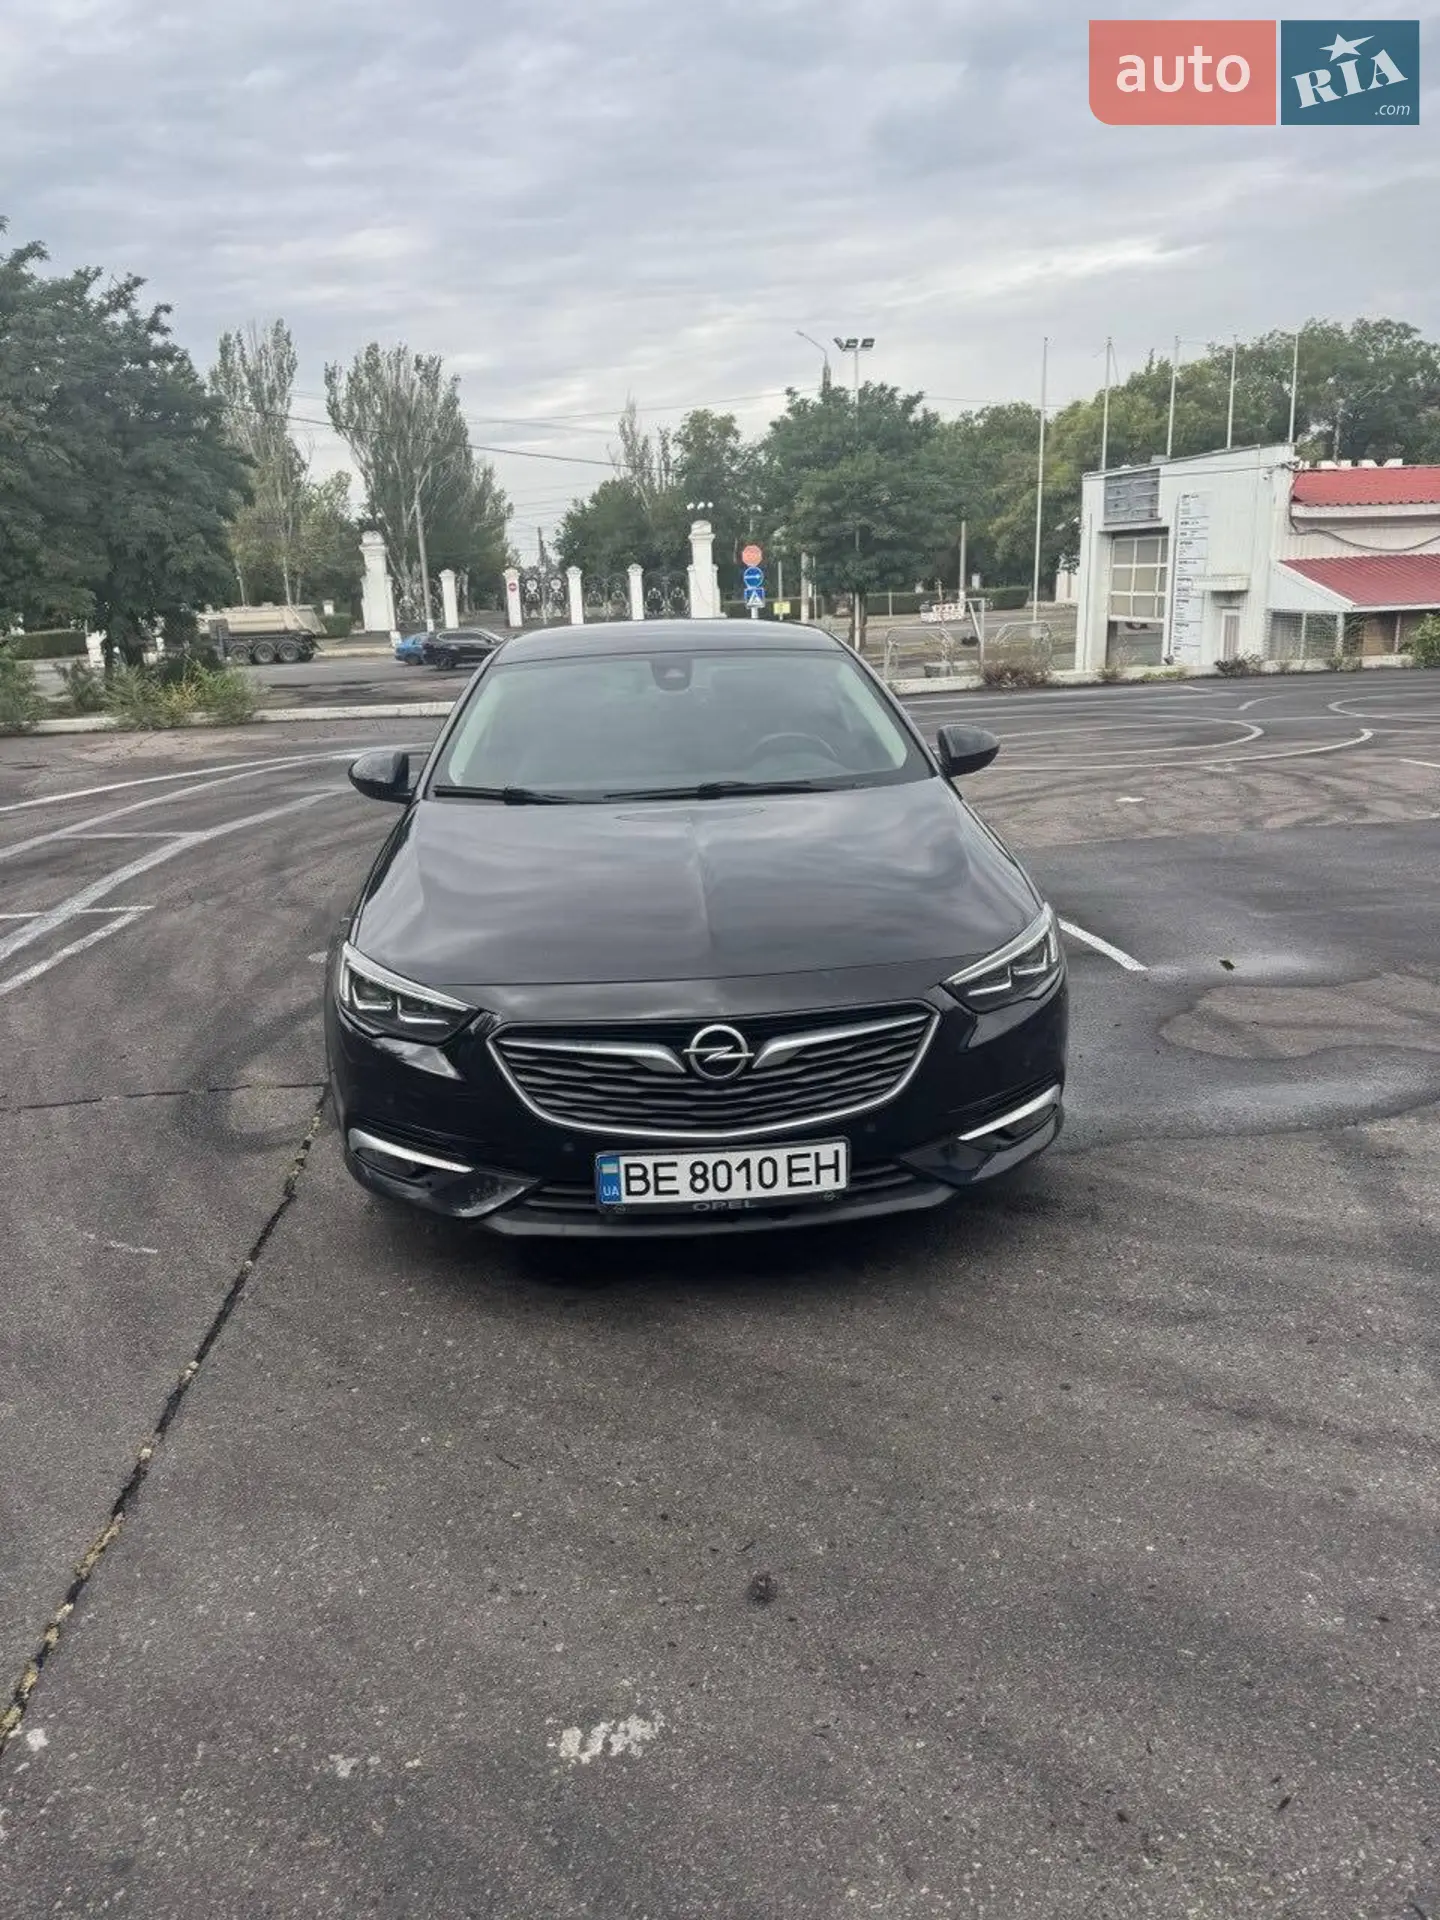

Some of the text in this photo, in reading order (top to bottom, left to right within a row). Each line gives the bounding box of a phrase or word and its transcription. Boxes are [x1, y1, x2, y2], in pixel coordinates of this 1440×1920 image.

[623, 1150, 840, 1197] BE 8010 EH
[602, 1186, 620, 1198] UA
[692, 1199, 759, 1212] OPEL
